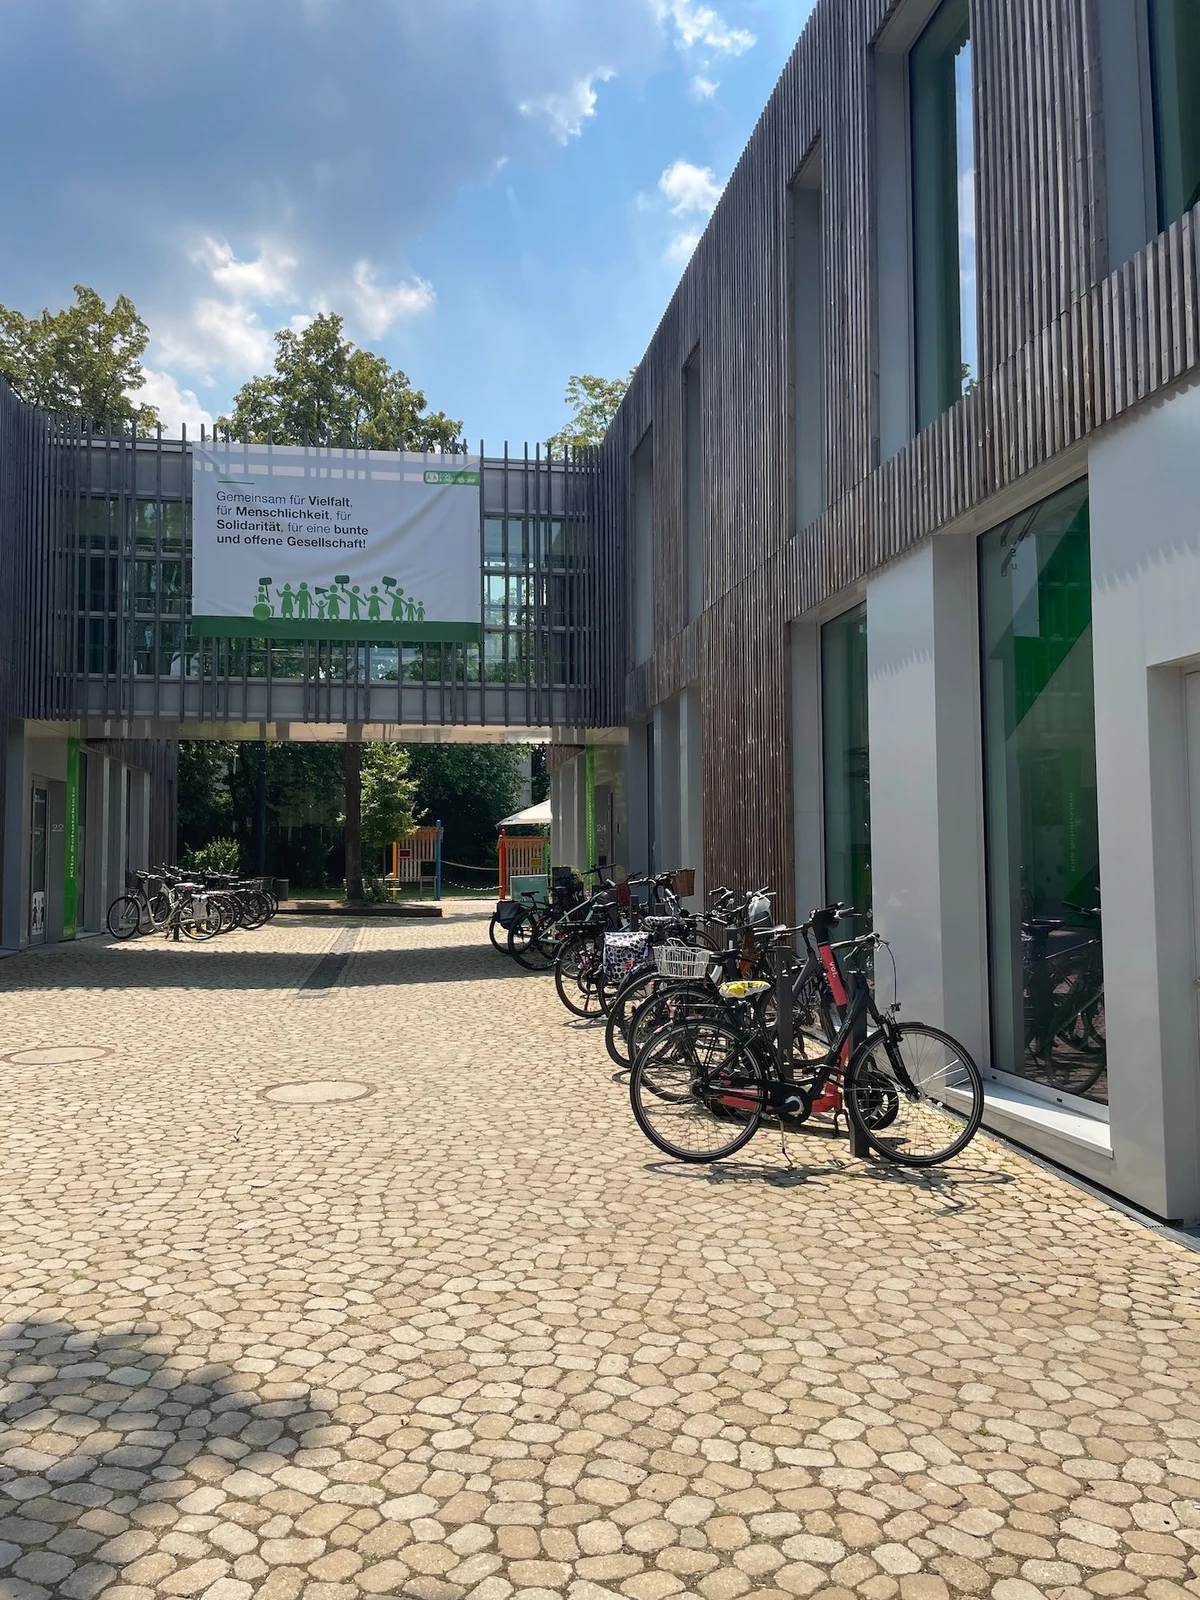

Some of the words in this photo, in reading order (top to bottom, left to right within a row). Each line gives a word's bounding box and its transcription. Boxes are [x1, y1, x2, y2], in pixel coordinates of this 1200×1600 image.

[216, 491, 286, 505] Gemeinsam
[290, 495, 305, 505] für
[308, 496, 353, 508] Vielfalt,
[216, 505, 232, 516] für
[236, 506, 333, 521] Menschlichkeit,
[336, 511, 352, 521] für
[216, 519, 284, 532] Solidarität,
[288, 522, 303, 532] für
[306, 524, 331, 534] eine
[334, 524, 368, 536] bunte
[216, 534, 240, 544] und
[244, 535, 283, 546] offene
[287, 537, 366, 549] Gesellschaft!
[52, 824, 64, 832] 22
[596, 824, 607, 832] 24
